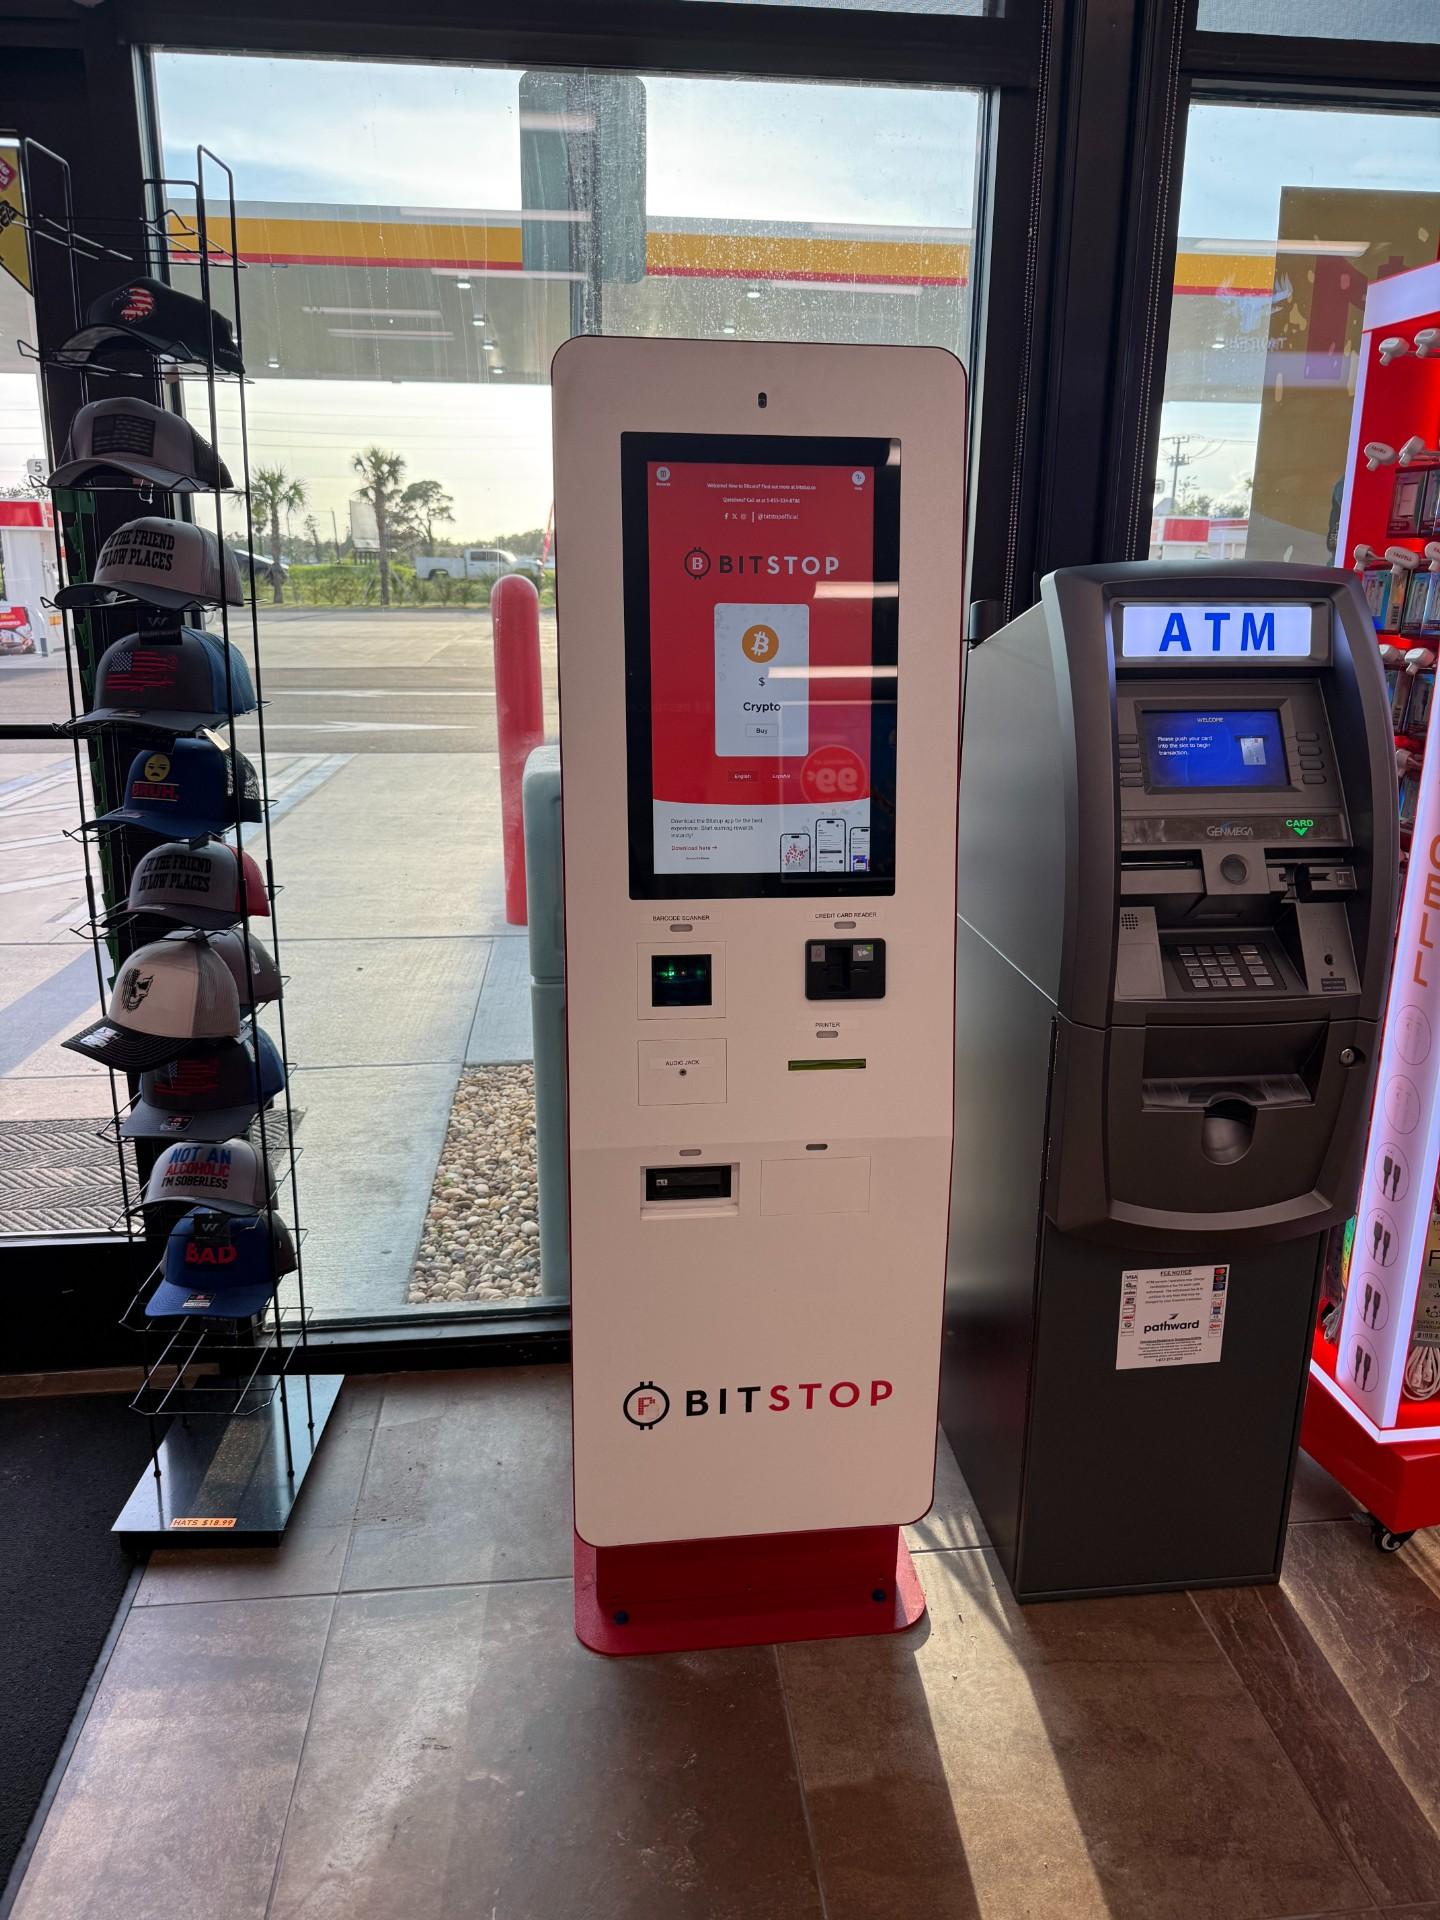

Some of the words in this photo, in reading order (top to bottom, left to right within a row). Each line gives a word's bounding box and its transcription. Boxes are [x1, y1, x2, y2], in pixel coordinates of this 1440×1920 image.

[34, 461, 43, 473] 5
[132, 529, 175, 551] FRIEND
[128, 548, 174, 571] PLACES
[719, 554, 840, 576] BITSTOP
[1158, 611, 1276, 652] ATM
[743, 701, 781, 714] Crypto
[756, 727, 768, 735] Buy
[1286, 819, 1314, 827] CARD
[172, 855, 212, 873] FRIEND
[147, 873, 168, 890] LOW
[168, 873, 210, 892] PLACES
[169, 1146, 202, 1164] NOT
[206, 1148, 232, 1164] AN
[165, 1161, 231, 1178] ALCOHOLIC
[161, 1176, 174, 1188] I'M
[174, 1175, 229, 1190] SOBERLESS
[185, 1241, 238, 1265] BAD
[1143, 1320, 1200, 1334] pathward
[686, 1380, 894, 1417] BITSTOP
